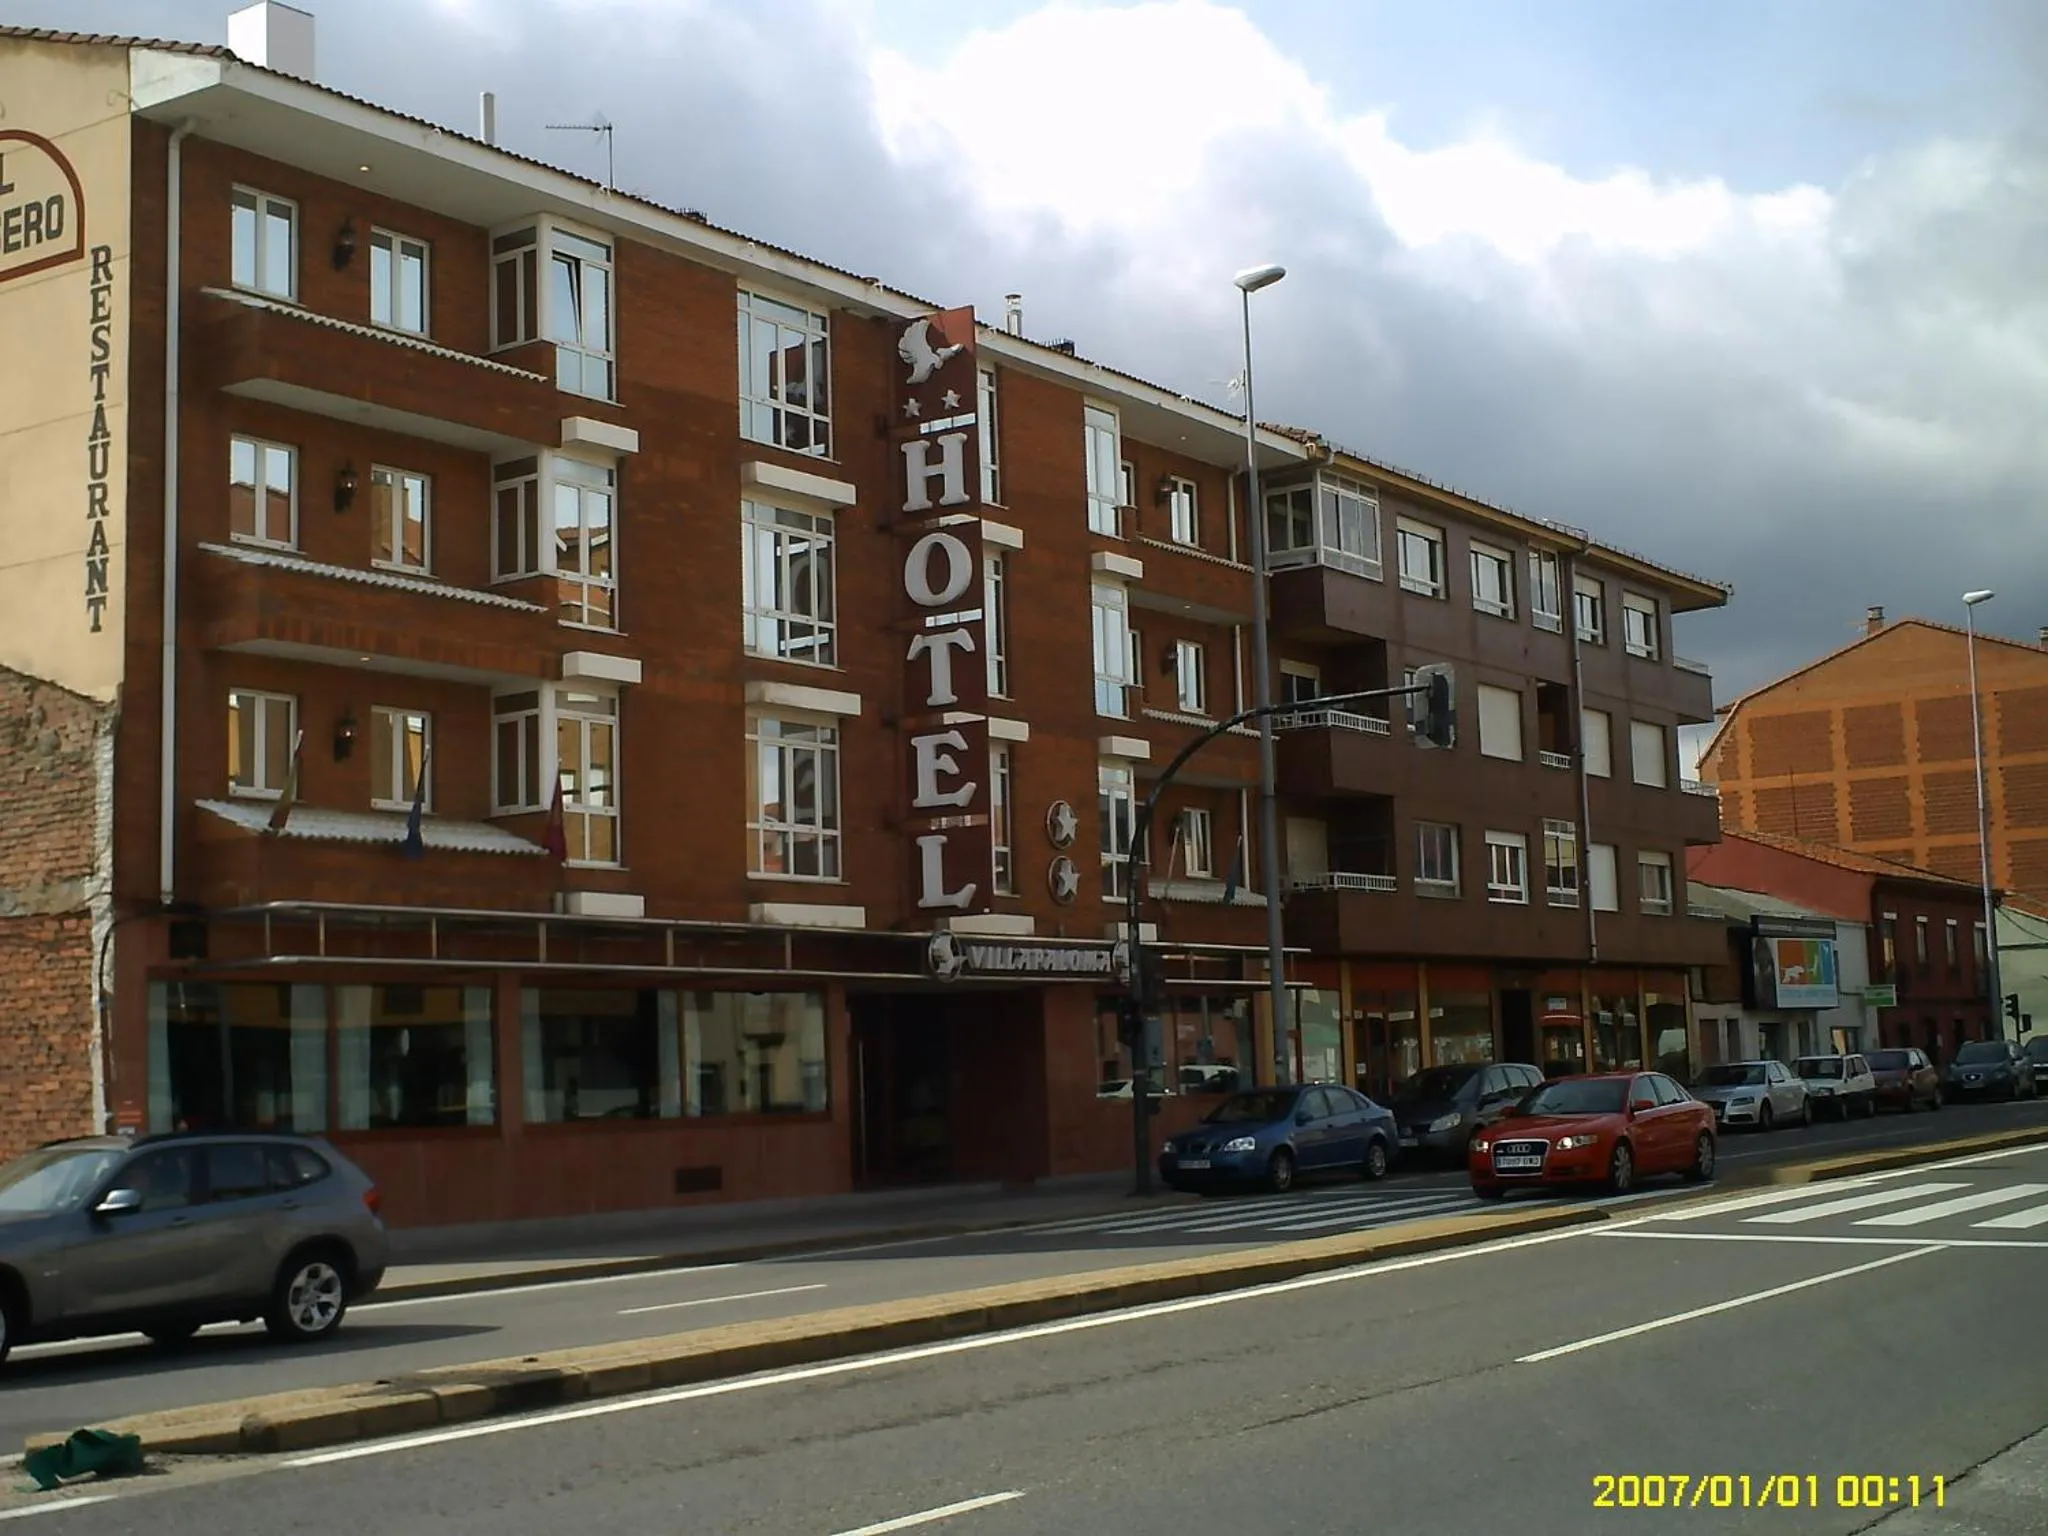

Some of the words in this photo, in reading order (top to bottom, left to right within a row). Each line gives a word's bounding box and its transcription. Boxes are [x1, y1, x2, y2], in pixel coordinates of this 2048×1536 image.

[0, 194, 64, 254] ERO
[85, 245, 113, 633] RESTAURANT
[901, 433, 976, 909] HOTEL
[967, 946, 1111, 972] VILLAPALOMA
